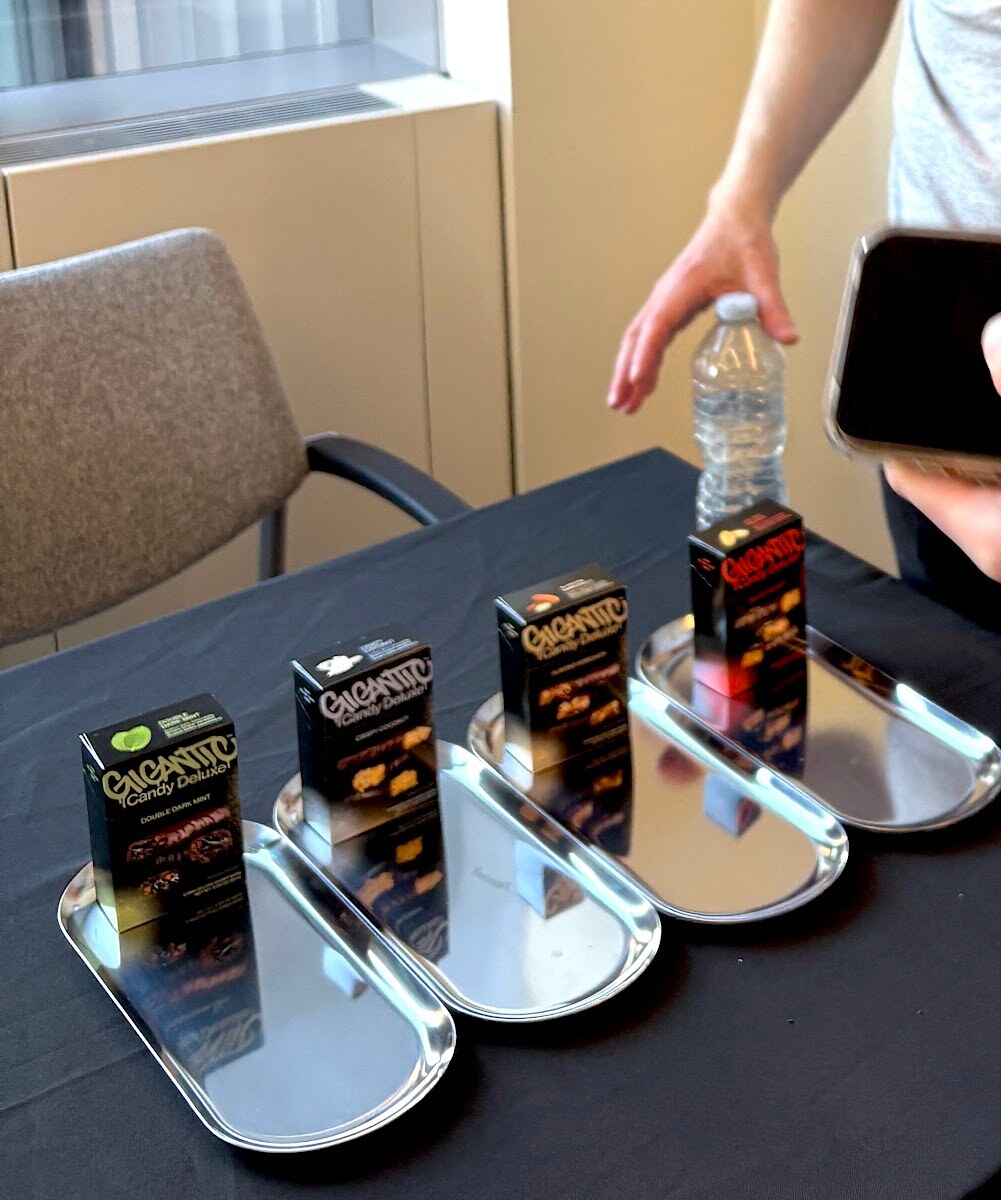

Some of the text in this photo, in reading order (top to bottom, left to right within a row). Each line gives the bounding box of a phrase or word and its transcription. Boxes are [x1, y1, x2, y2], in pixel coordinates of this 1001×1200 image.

[521, 597, 629, 660] GIGANTIC
[319, 657, 434, 728] GIGANTIC
[102, 735, 238, 808] GIGANTIC
[126, 763, 228, 808] Candy Deluxe
[140, 793, 212, 825] DOUBLE DARK MINT
